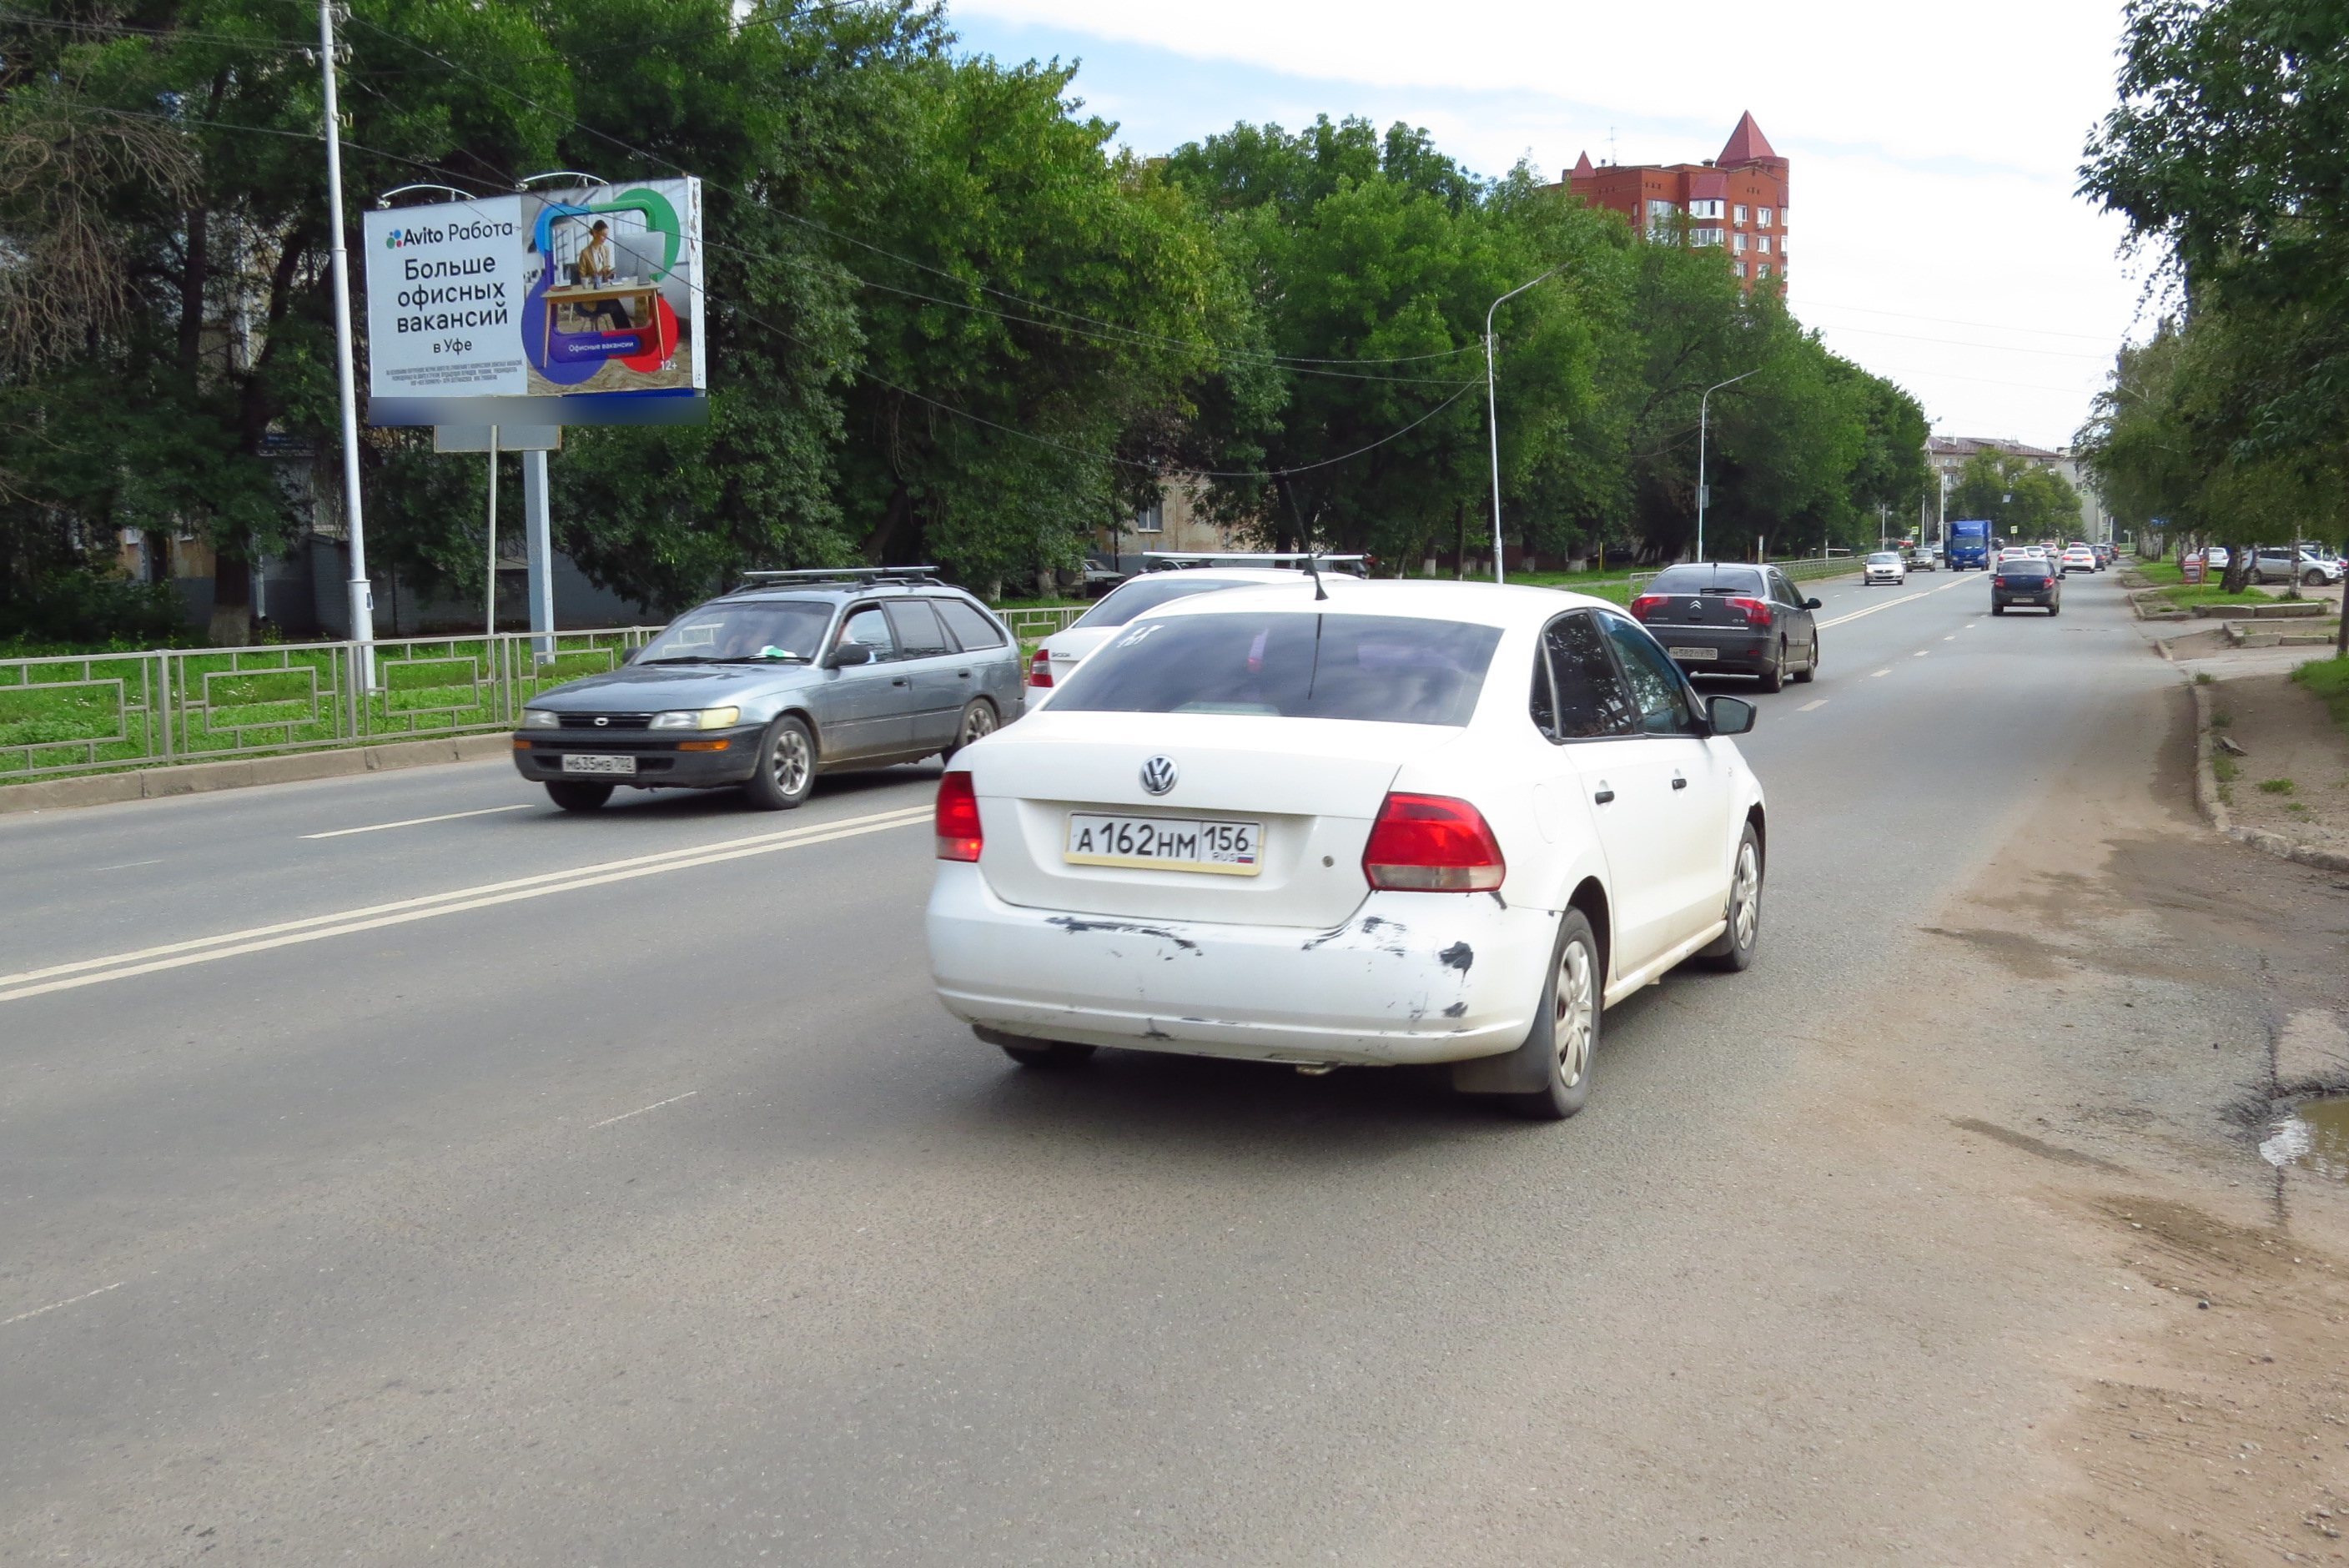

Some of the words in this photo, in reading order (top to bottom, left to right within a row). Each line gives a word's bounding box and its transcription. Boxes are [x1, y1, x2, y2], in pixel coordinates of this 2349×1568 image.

[403, 226, 444, 247] Avito
[449, 221, 513, 242] Работа
[405, 256, 496, 281] Больше
[397, 282, 506, 312] офисных
[397, 301, 508, 334] вакансий
[433, 343, 441, 354] в
[444, 338, 472, 356] Уфе
[568, 344, 601, 353] Офисные
[601, 341, 635, 349] вакансии
[660, 359, 678, 371] 12+
[1202, 826, 1250, 852] 156
[1212, 852, 1236, 862] RUS
